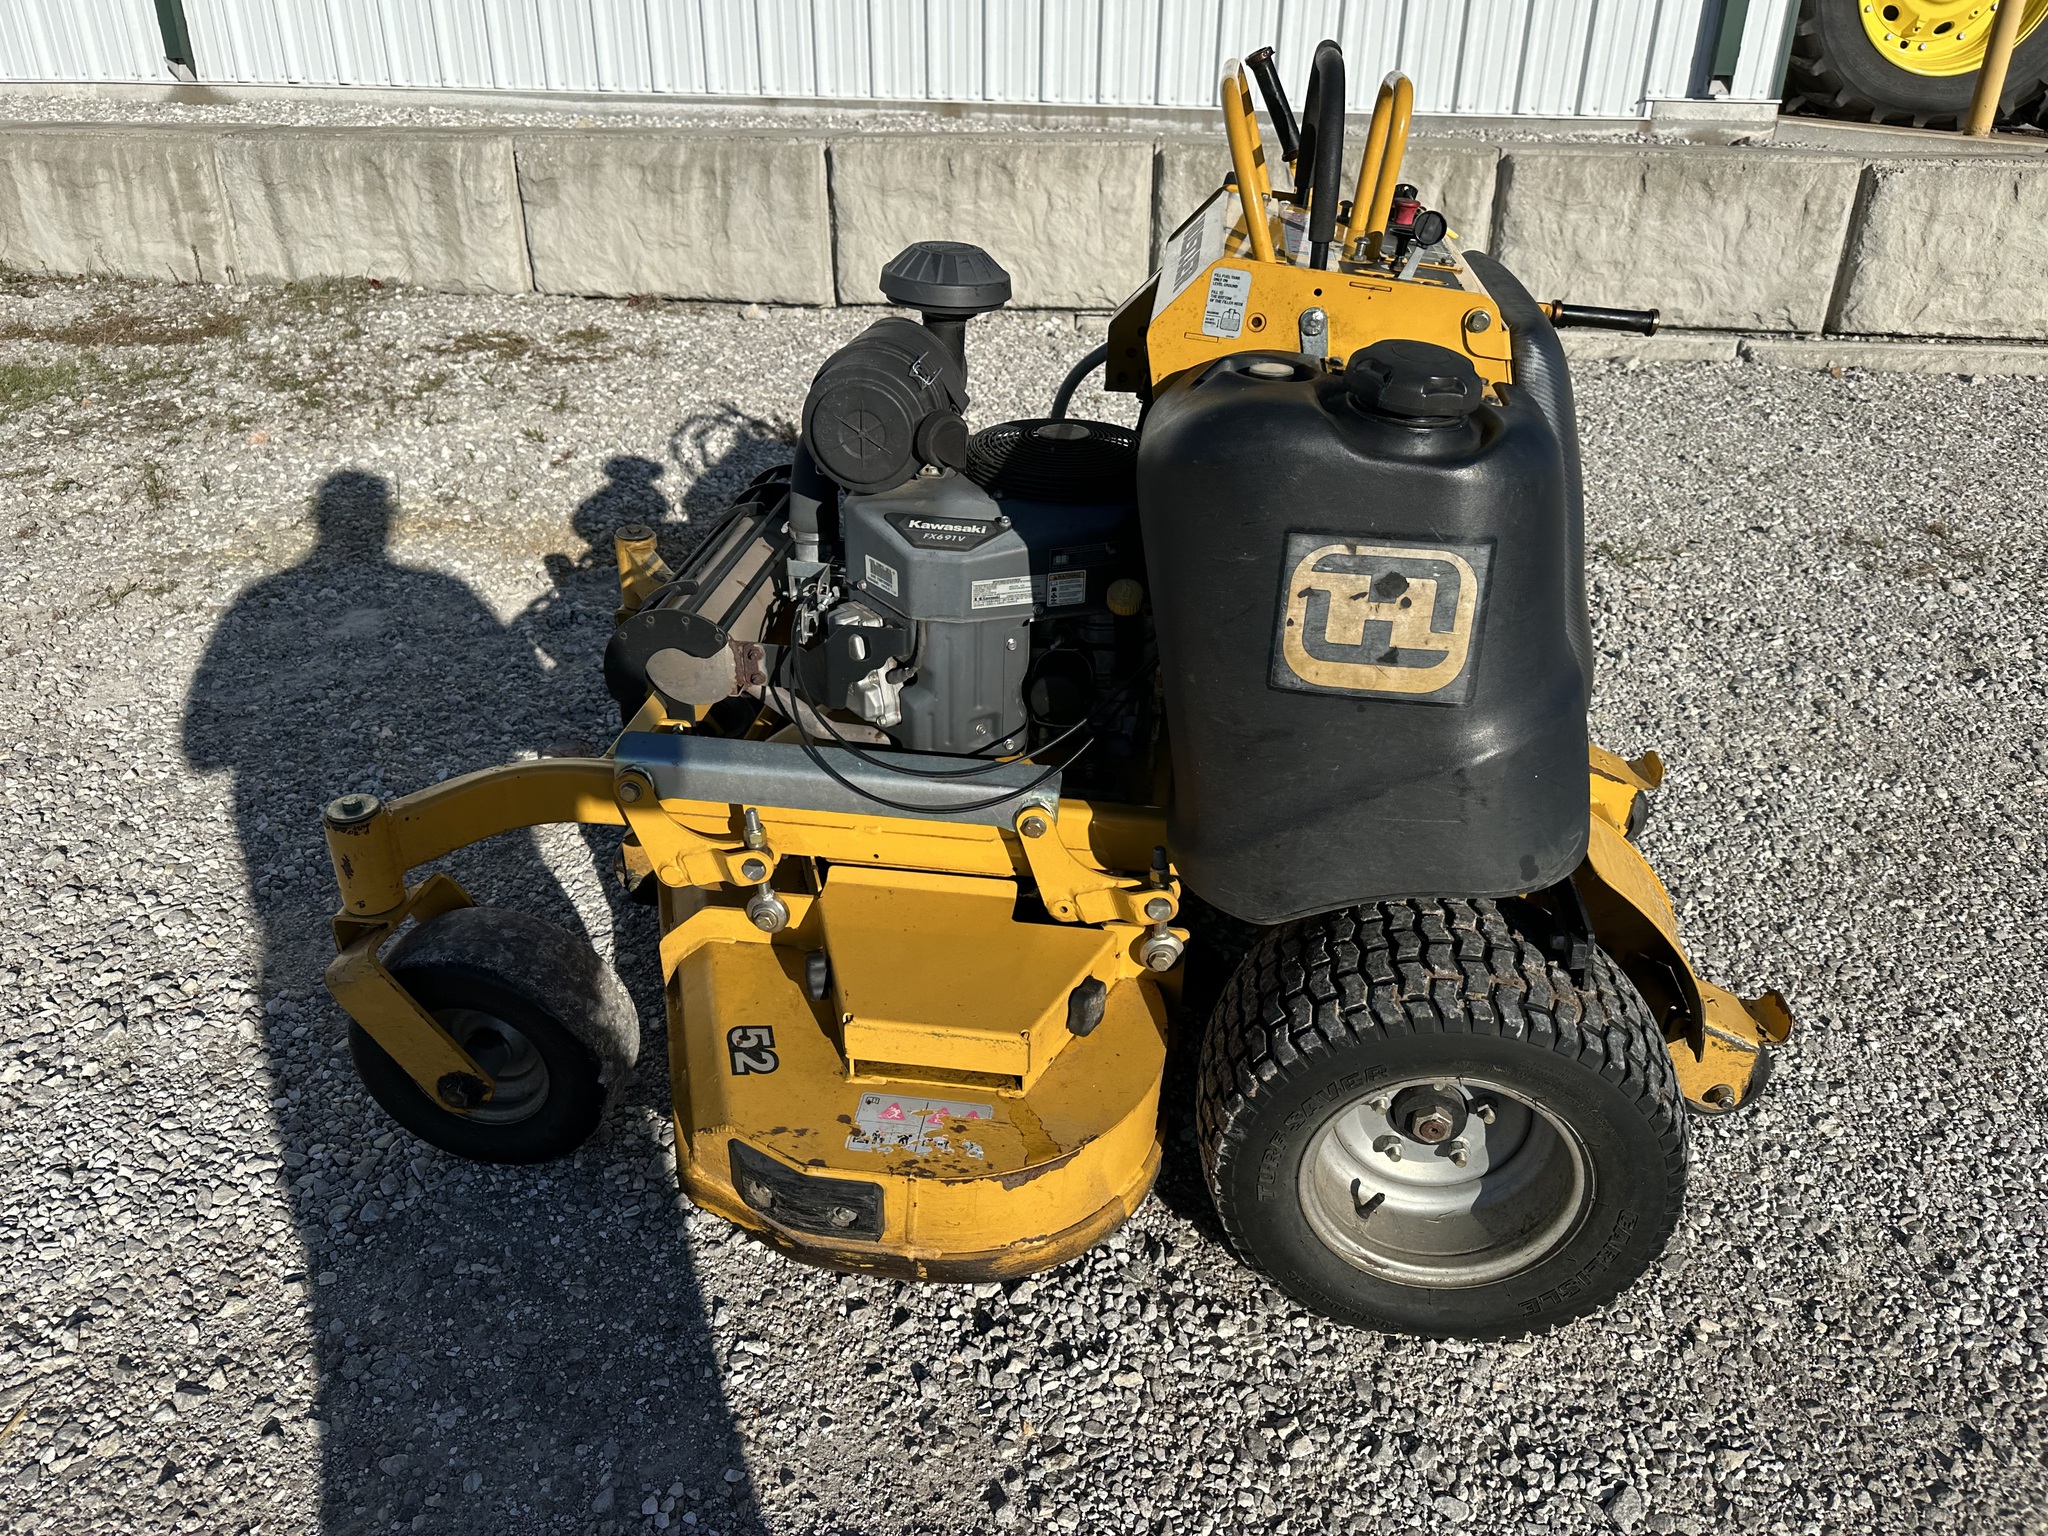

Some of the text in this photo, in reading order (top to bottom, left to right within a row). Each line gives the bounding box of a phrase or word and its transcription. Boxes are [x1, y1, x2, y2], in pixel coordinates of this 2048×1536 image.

[1173, 212, 1206, 294] HUSTLER
[908, 519, 987, 534] Kawasaki
[922, 532, 966, 542] FX691V
[727, 1025, 779, 1075] 52
[1256, 1064, 1389, 1201] TURF SAVER
[1518, 1208, 1639, 1318] CARLISLE
